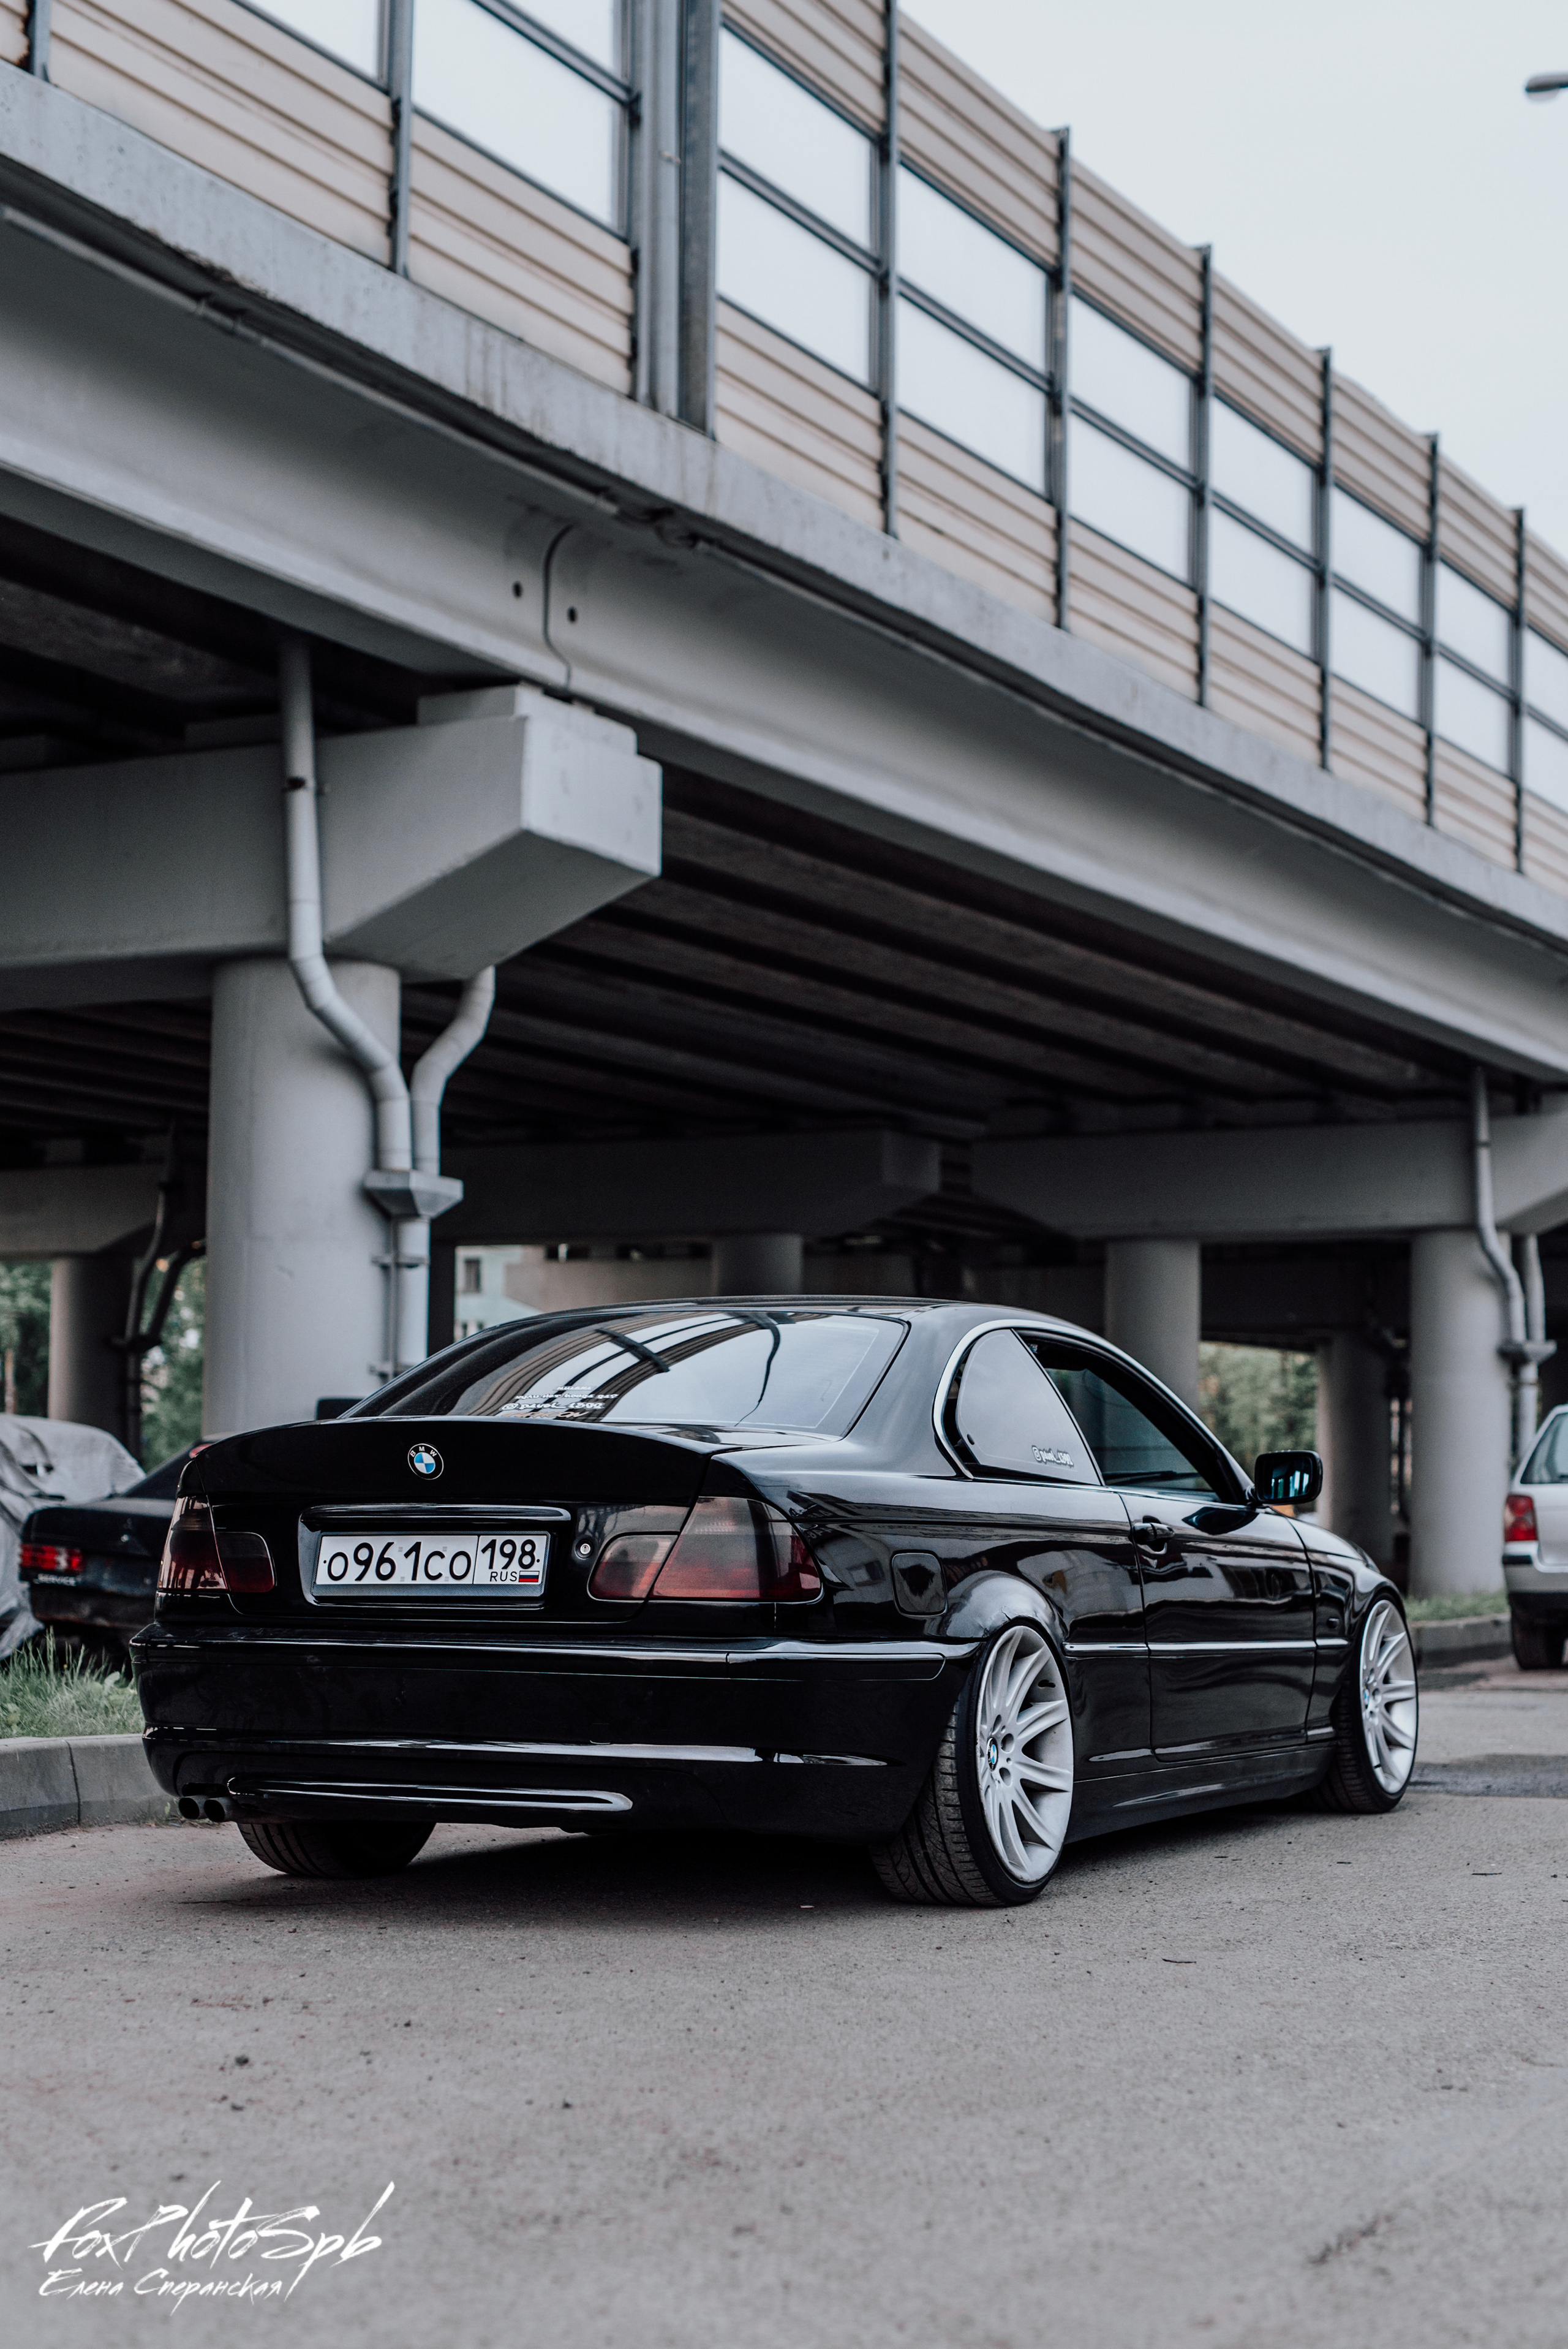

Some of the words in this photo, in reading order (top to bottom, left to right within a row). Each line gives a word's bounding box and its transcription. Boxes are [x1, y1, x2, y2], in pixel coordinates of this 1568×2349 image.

[410, 1446, 437, 1458] BMW
[481, 1539, 536, 1570] 198
[490, 1571, 518, 1583] RUS
